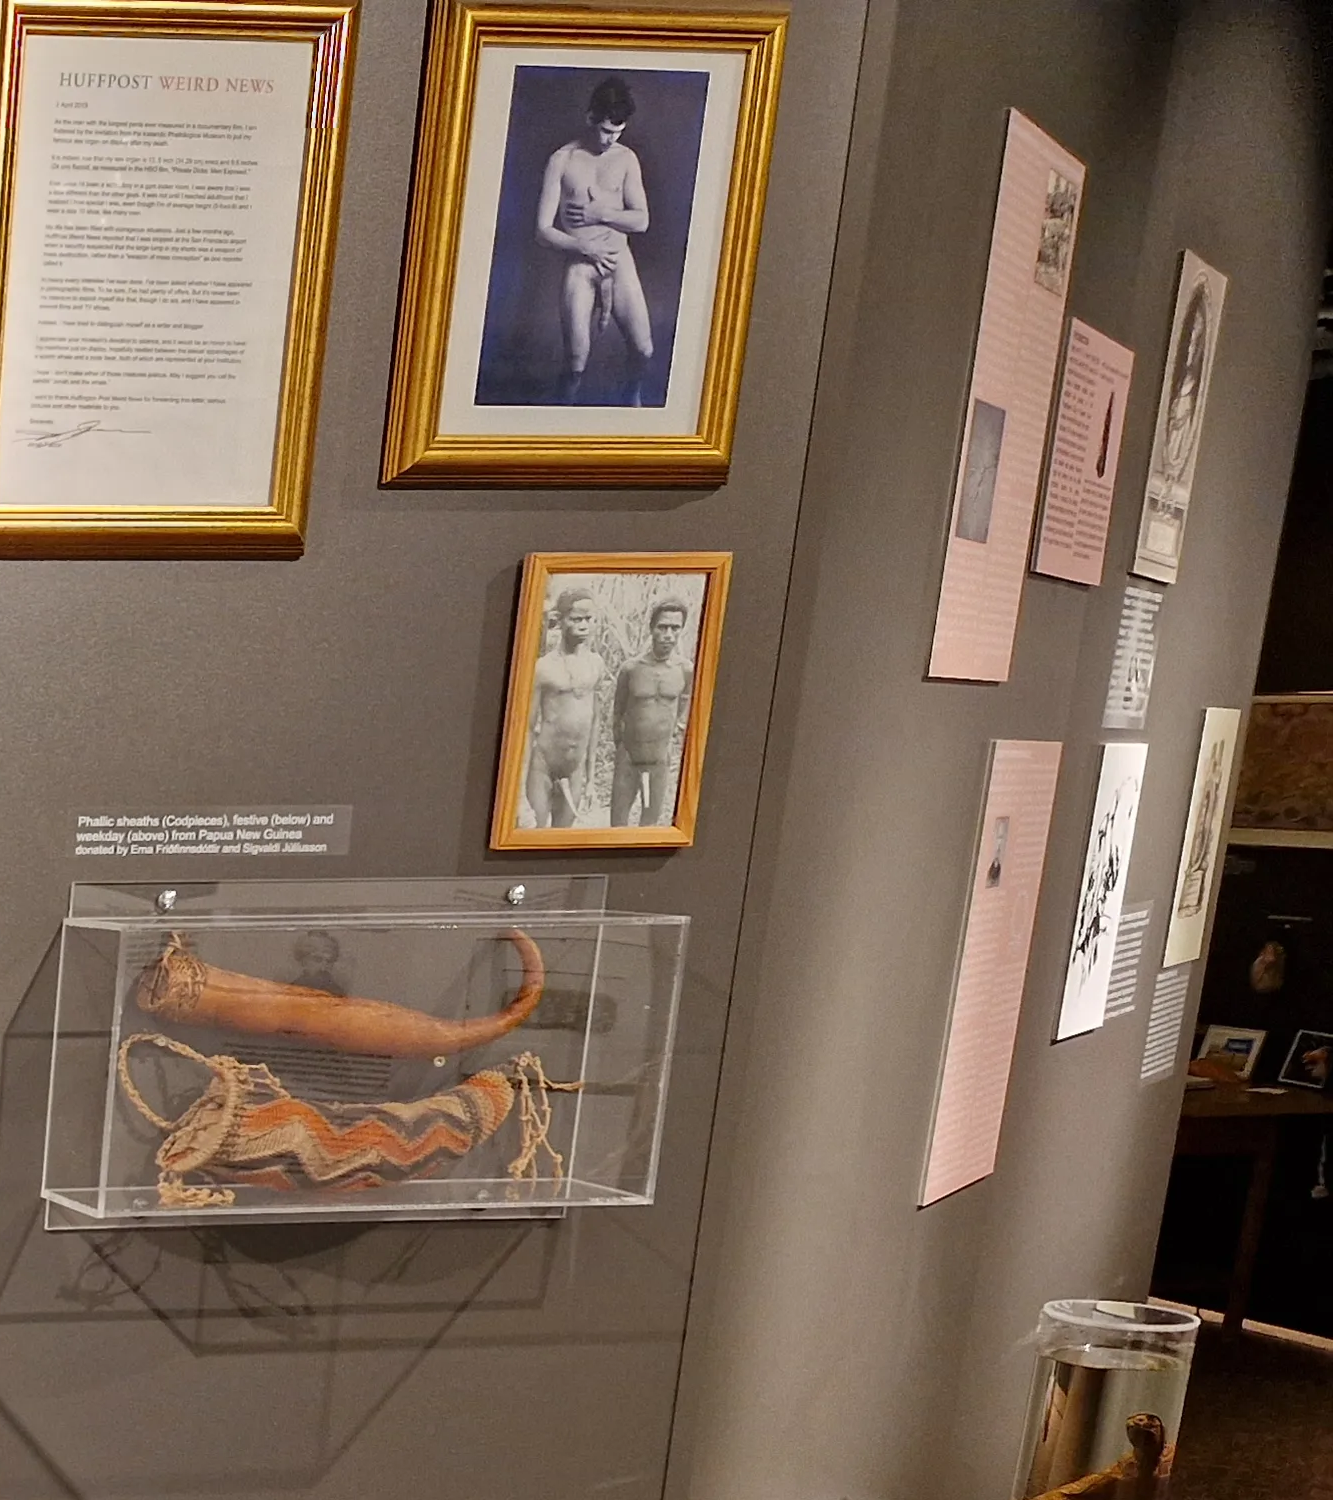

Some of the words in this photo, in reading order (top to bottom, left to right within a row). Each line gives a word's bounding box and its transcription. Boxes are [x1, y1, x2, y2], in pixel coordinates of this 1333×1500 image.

[59, 71, 152, 90] HUFFPOST
[159, 75, 219, 92] WEIRD
[225, 77, 275, 94] NEWS
[78, 815, 115, 827] Phallic
[116, 815, 159, 827] sheaths
[162, 815, 230, 829] (Codpieces),
[232, 814, 269, 826] festive
[271, 813, 311, 827] (below)
[313, 813, 334, 825] and
[76, 830, 126, 844] weekday
[127, 829, 169, 843] (above)
[171, 829, 196, 841] from
[198, 829, 233, 843] Papua
[236, 828, 261, 841] New
[263, 828, 303, 840] Guinea
[75, 843, 115, 855] donated
[116, 844, 128, 857] by
[222, 842, 241, 854] and
